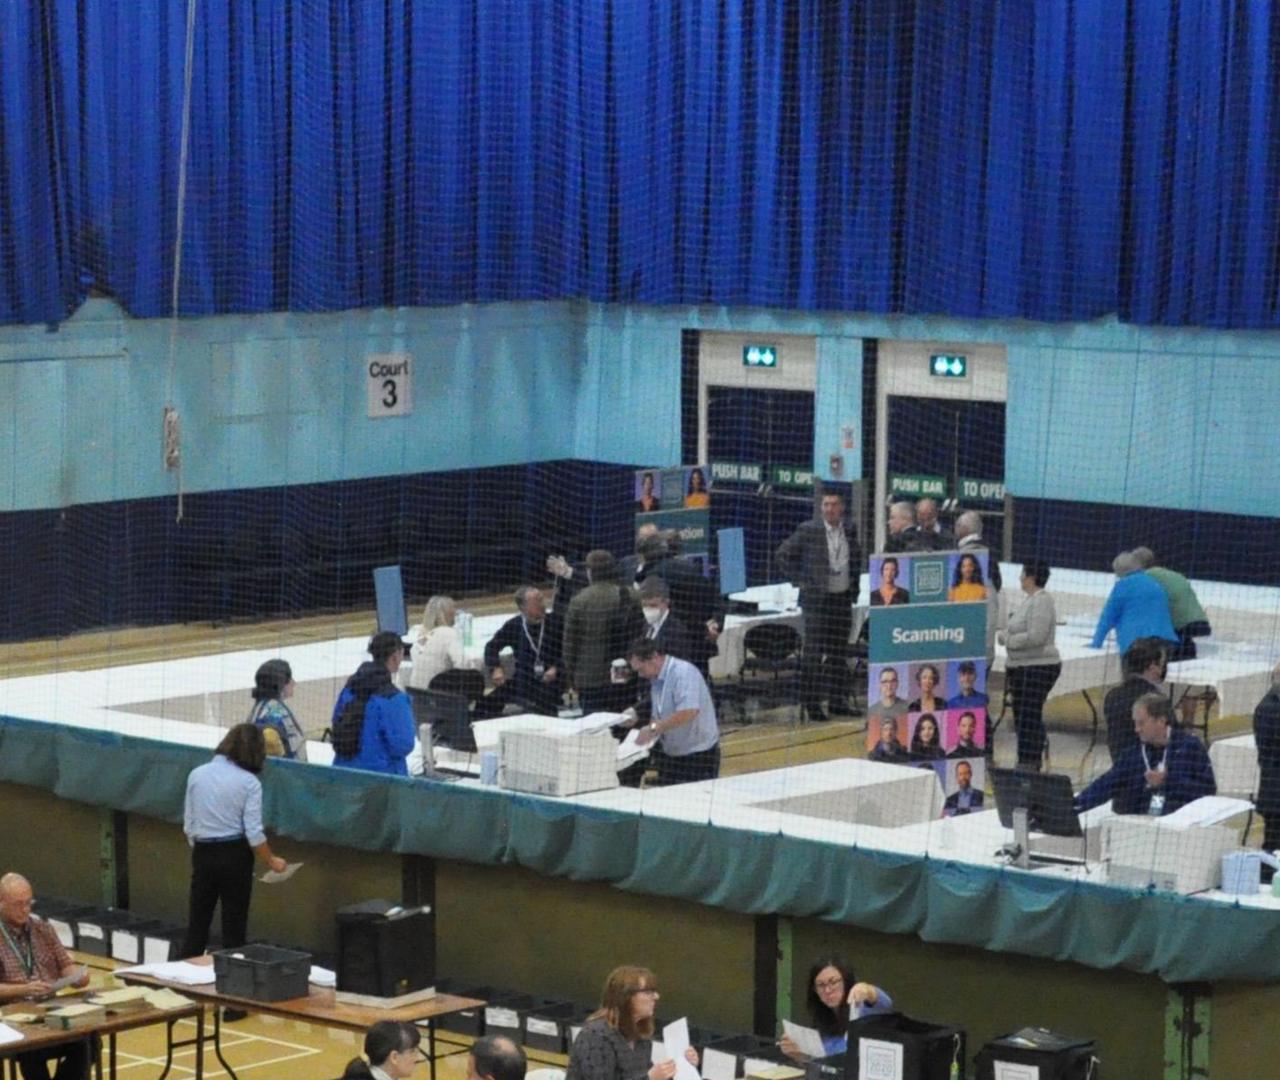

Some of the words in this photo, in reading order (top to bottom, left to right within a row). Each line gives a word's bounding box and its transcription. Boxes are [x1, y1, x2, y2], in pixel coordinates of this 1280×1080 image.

[369, 359, 409, 378] Court
[382, 379, 398, 408] 3
[712, 463, 738, 479] PUSH
[740, 465, 760, 481] BAR
[778, 469, 792, 482] TO
[892, 478, 919, 492] PUSH
[922, 480, 944, 494] BAR
[963, 481, 978, 497] TO
[892, 625, 965, 644] Scanning
